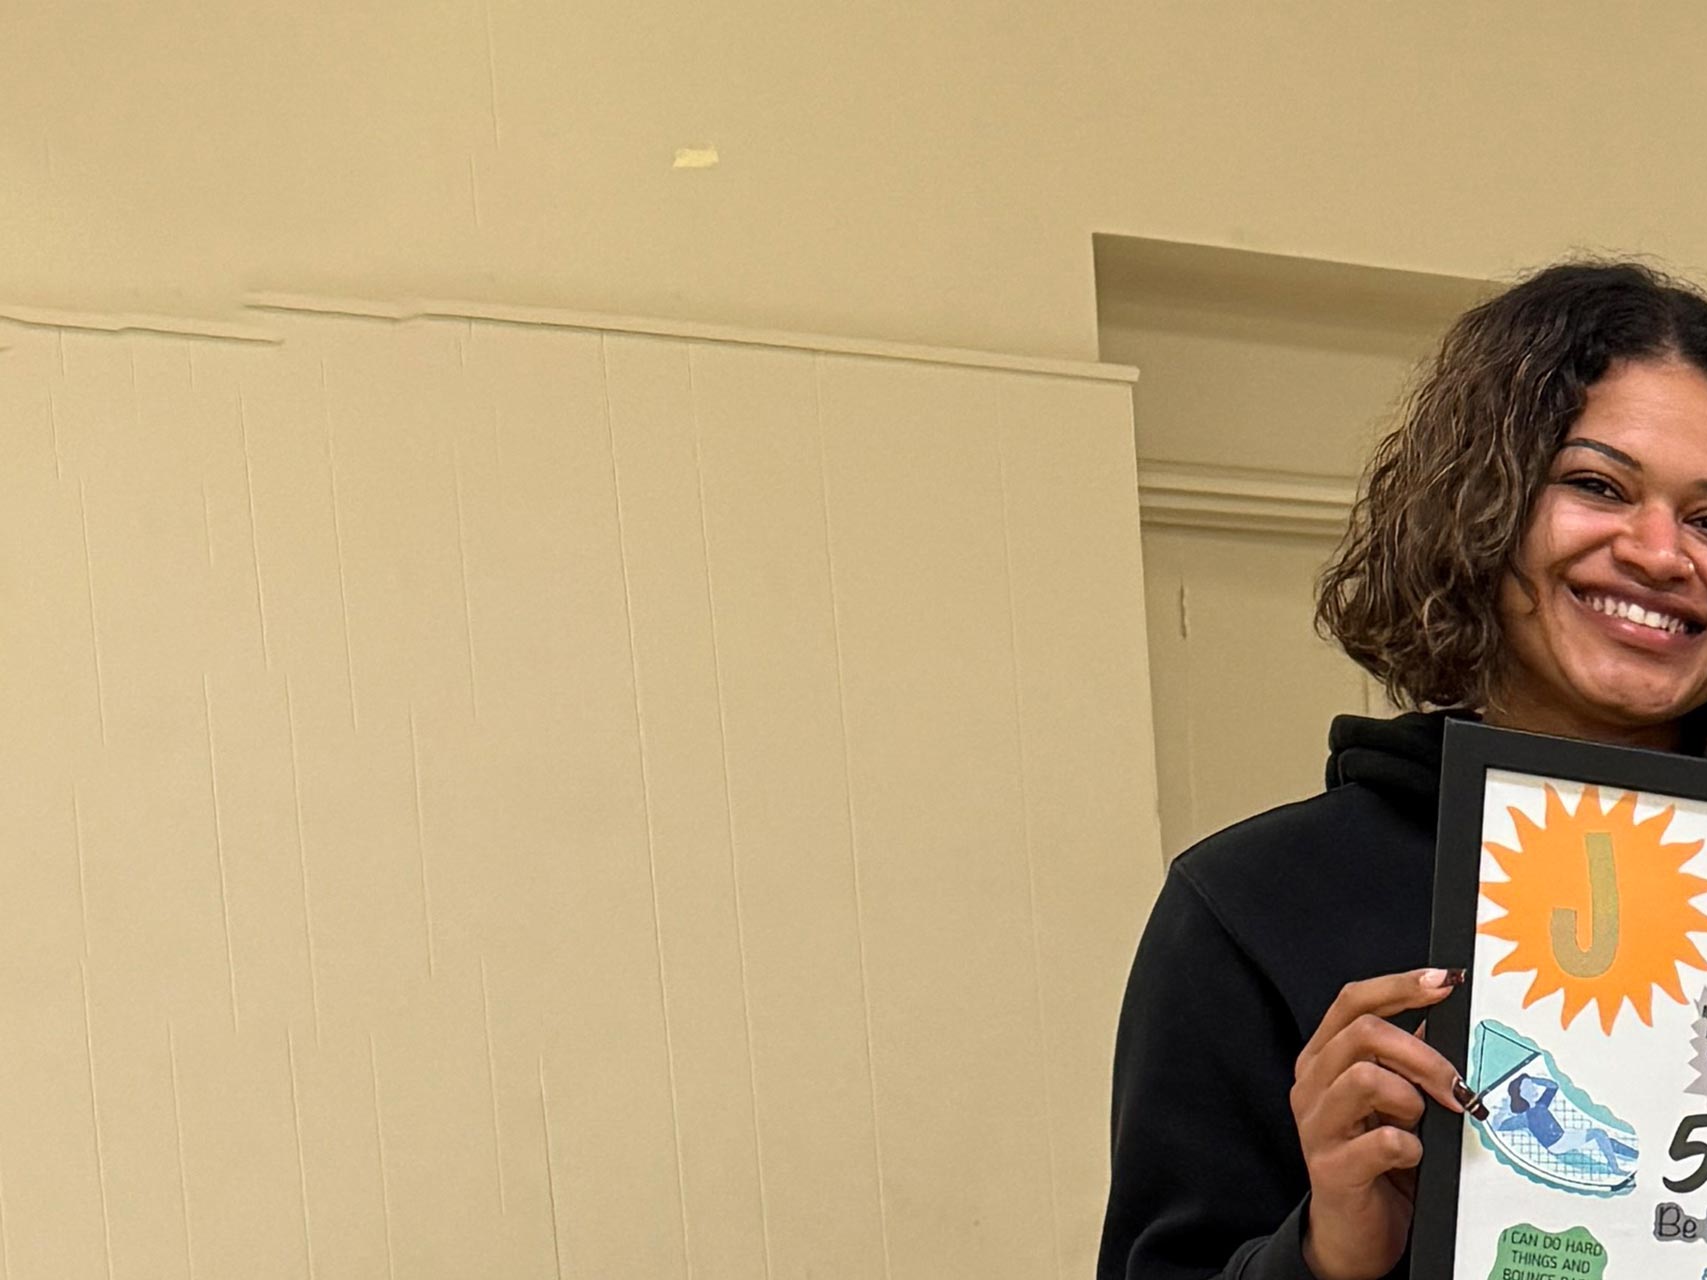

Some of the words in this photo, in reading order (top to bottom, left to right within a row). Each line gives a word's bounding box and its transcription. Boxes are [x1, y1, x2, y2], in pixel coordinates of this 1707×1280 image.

[1550, 831, 1617, 977] J
[1658, 1206, 1697, 1239] Be
[1511, 1231, 1538, 1247] CAN
[1543, 1236, 1561, 1251] DO
[1566, 1239, 1603, 1256] HARD
[1511, 1250, 1558, 1269] THINGS
[1562, 1259, 1590, 1274] AND
